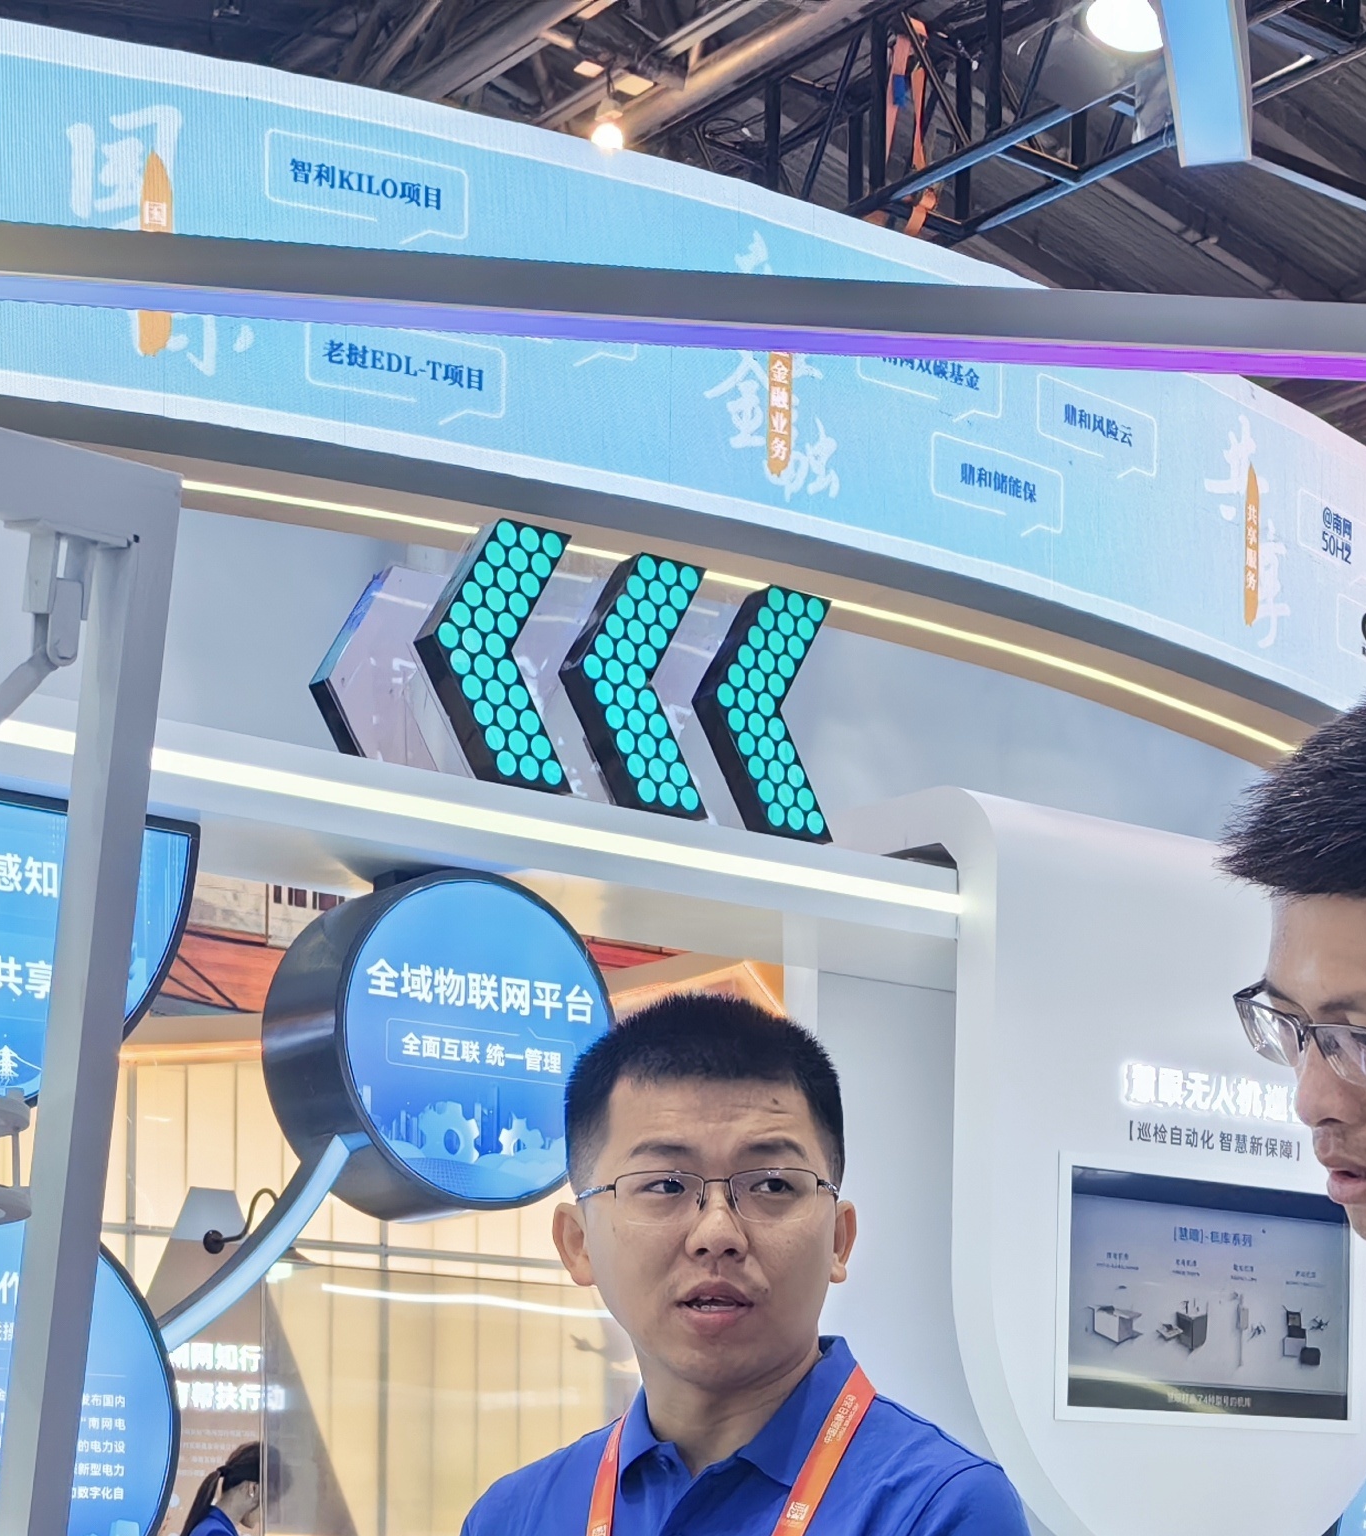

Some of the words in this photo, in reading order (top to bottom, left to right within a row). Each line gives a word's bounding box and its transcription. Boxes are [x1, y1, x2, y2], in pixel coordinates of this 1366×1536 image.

[289, 157, 442, 211] 智利KILO项目
[322, 340, 484, 392] 老挝EDL-T项目
[881, 357, 980, 391] 双碳基金
[768, 351, 790, 461] 金融业务
[366, 957, 594, 1025] 全域物联网平台
[401, 1032, 480, 1064] 全面互联
[485, 1044, 562, 1075] 统一管理
[74, 1462, 125, 1477] 新型电力
